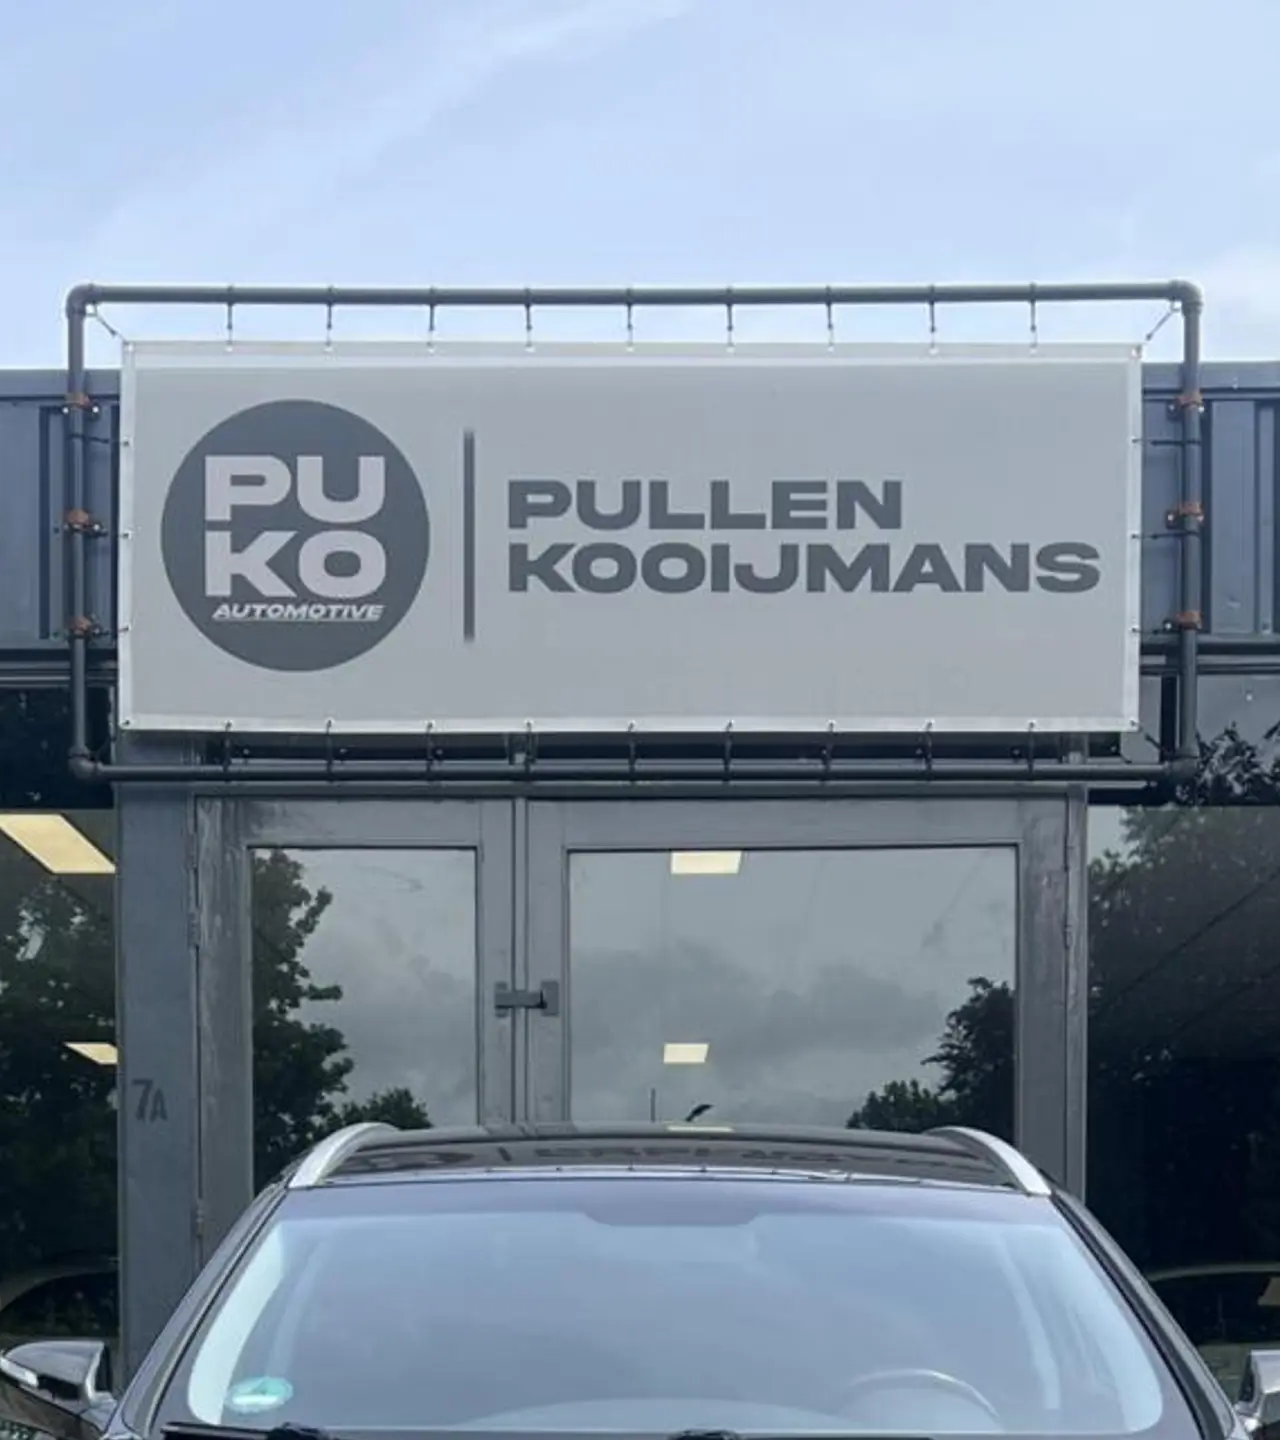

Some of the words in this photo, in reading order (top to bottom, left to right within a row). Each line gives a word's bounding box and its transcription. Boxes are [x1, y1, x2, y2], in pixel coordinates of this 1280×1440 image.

[205, 455, 386, 523] PU
[507, 480, 902, 531] PULLEN
[205, 531, 386, 599] KO
[508, 542, 1100, 594] KOOIJMANS
[211, 603, 385, 622] AUTOMOTIVE
[131, 1078, 168, 1123] 7A
